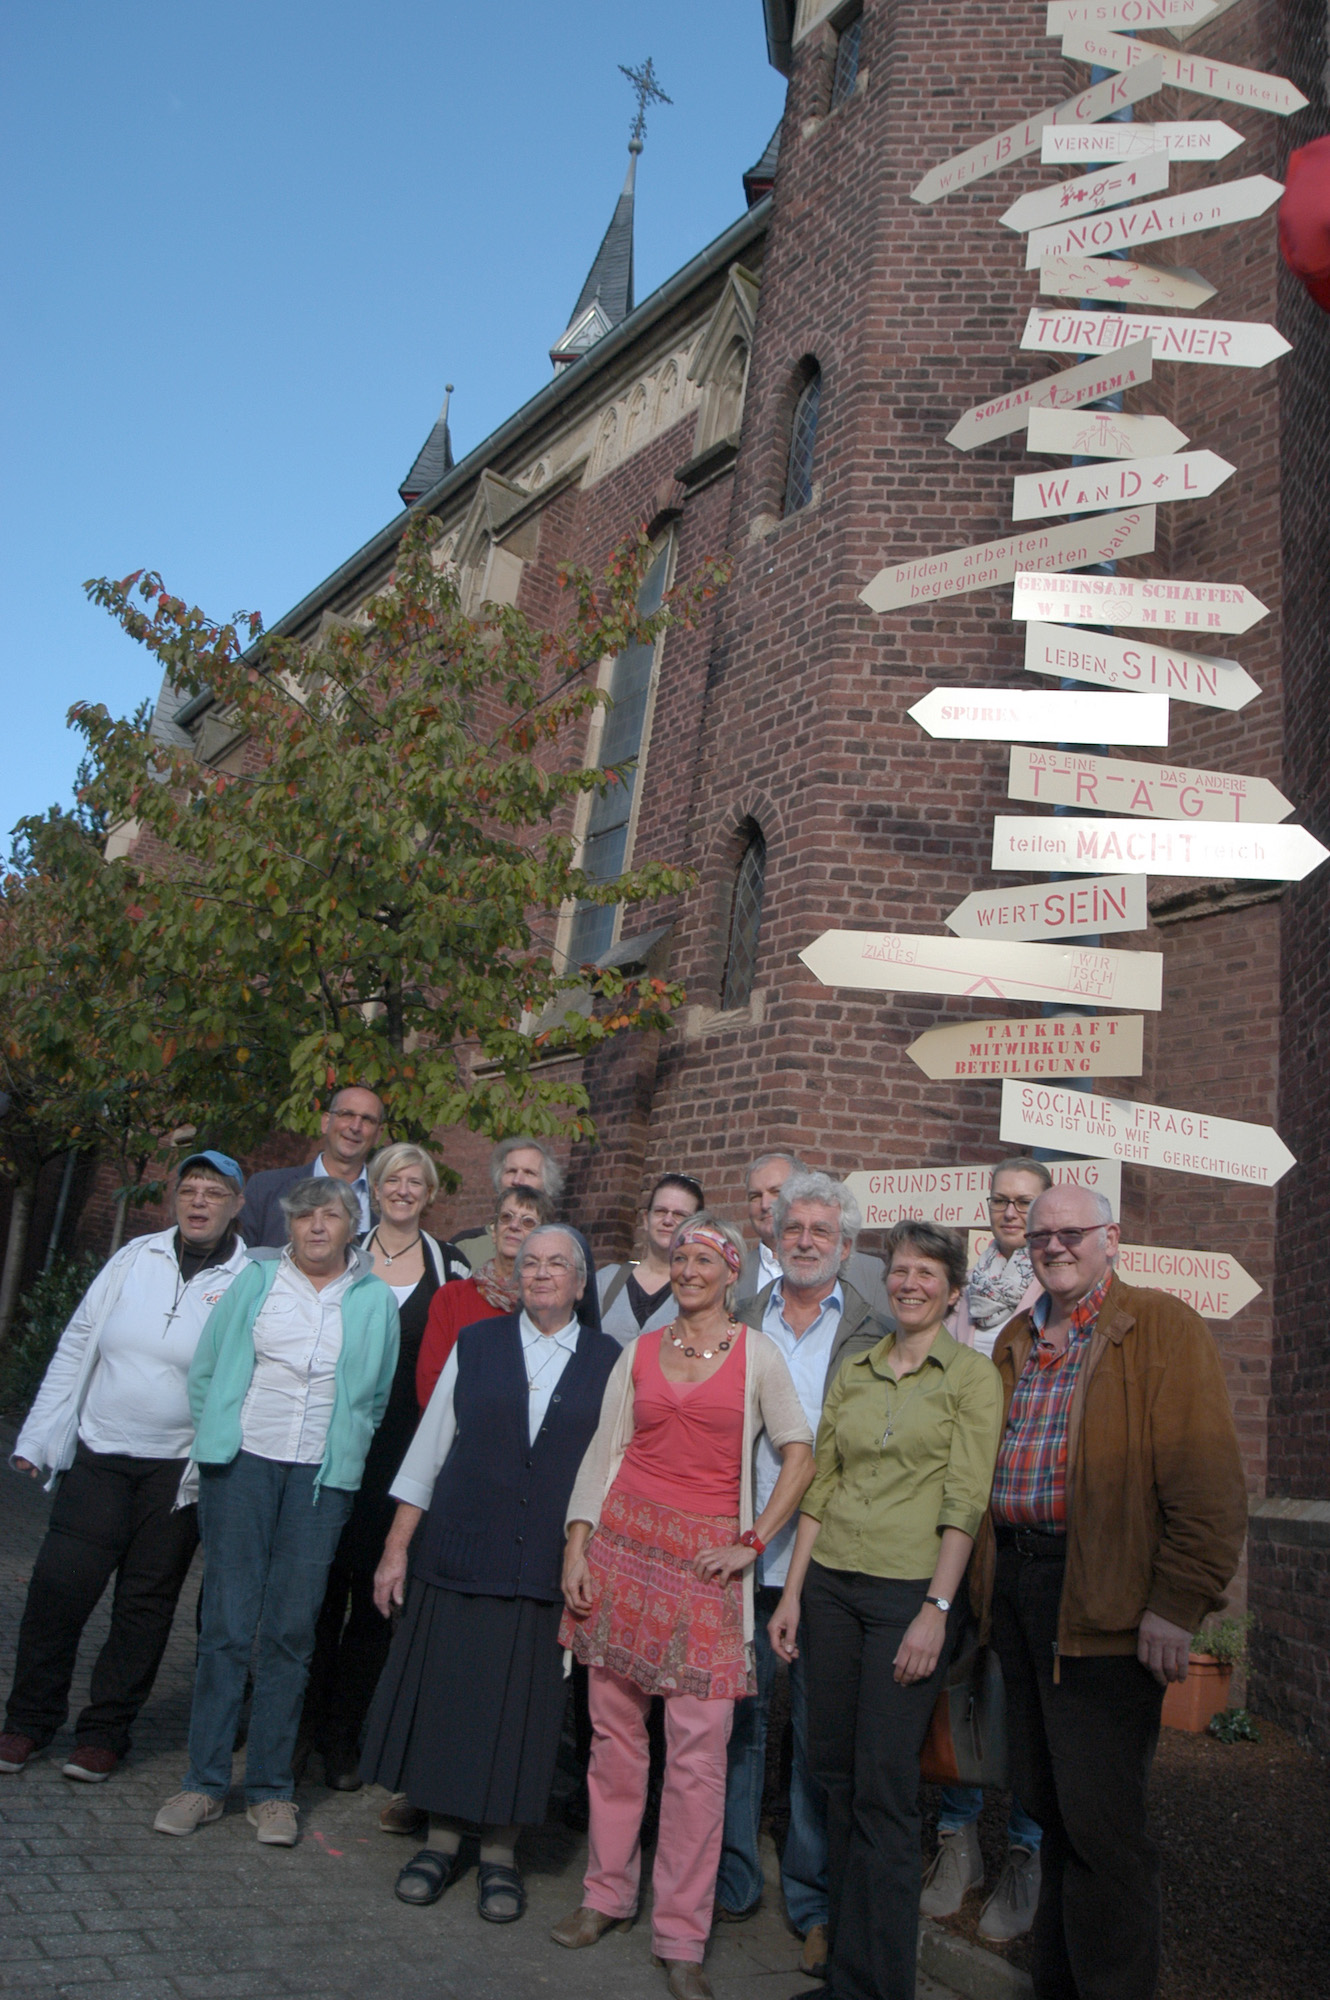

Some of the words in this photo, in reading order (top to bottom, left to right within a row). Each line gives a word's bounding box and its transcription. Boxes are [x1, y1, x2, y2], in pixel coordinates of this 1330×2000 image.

[1068, 0, 1194, 22] VISIONEN
[940, 77, 1128, 188] WEITBLICK
[1045, 207, 1221, 255] inNOVAtion
[975, 390, 1033, 422] SOZIAL
[1076, 369, 1136, 401] FIRMA
[896, 560, 948, 583] bilden
[963, 536, 1049, 567] arbeiten
[911, 567, 999, 599] begegnen
[1013, 547, 1088, 572] beraten
[1017, 577, 1134, 597] GEMEINSAM
[1142, 584, 1245, 604] SCHAFFEN
[1037, 602, 1093, 618] WIR
[1142, 608, 1221, 627] MEHR
[1029, 752, 1056, 767] DAS
[1064, 757, 1096, 772] EINE
[1160, 770, 1187, 784] DAS
[1195, 774, 1246, 792] ANDERE
[1009, 834, 1066, 854] teilen
[1077, 830, 1195, 863] MACHT
[985, 1022, 1119, 1038] TATKRAFT
[969, 1040, 1101, 1056] MITWIRKUNG
[955, 1058, 1091, 1074] BETEILIGUNG
[1022, 1088, 1112, 1122] SOCIALE
[1135, 1108, 1209, 1139] FRAGE
[1022, 1109, 1054, 1127] WAS
[1060, 1115, 1079, 1131] IST
[1087, 1121, 1117, 1138] UND
[1125, 1127, 1150, 1144] WIE
[1114, 1142, 1149, 1160] GEHT
[1163, 1151, 1268, 1181] GERECHTIGKEIT
[866, 1204, 924, 1223] Rechte
[933, 1203, 964, 1222] der
[1115, 1250, 1230, 1281] RELIGIONIS
